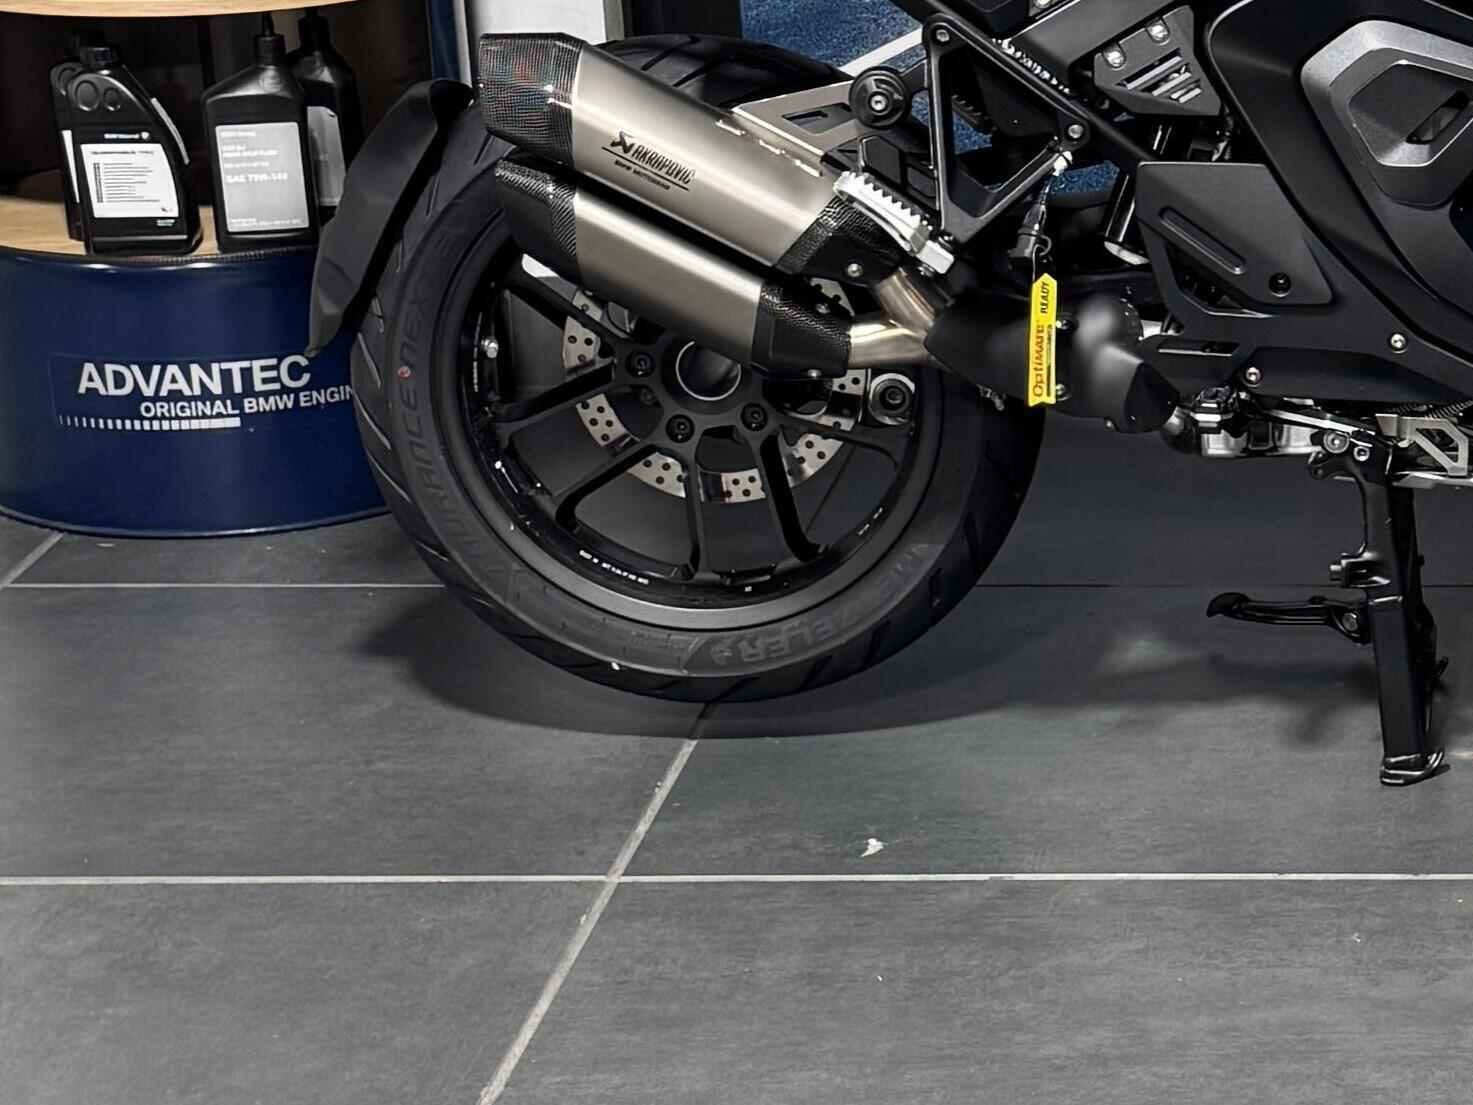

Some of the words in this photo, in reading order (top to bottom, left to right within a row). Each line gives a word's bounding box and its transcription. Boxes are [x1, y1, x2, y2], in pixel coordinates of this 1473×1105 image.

[78, 355, 311, 397] ADVANTEC
[140, 399, 240, 418] ORIGINAL
[244, 393, 295, 414] BMW
